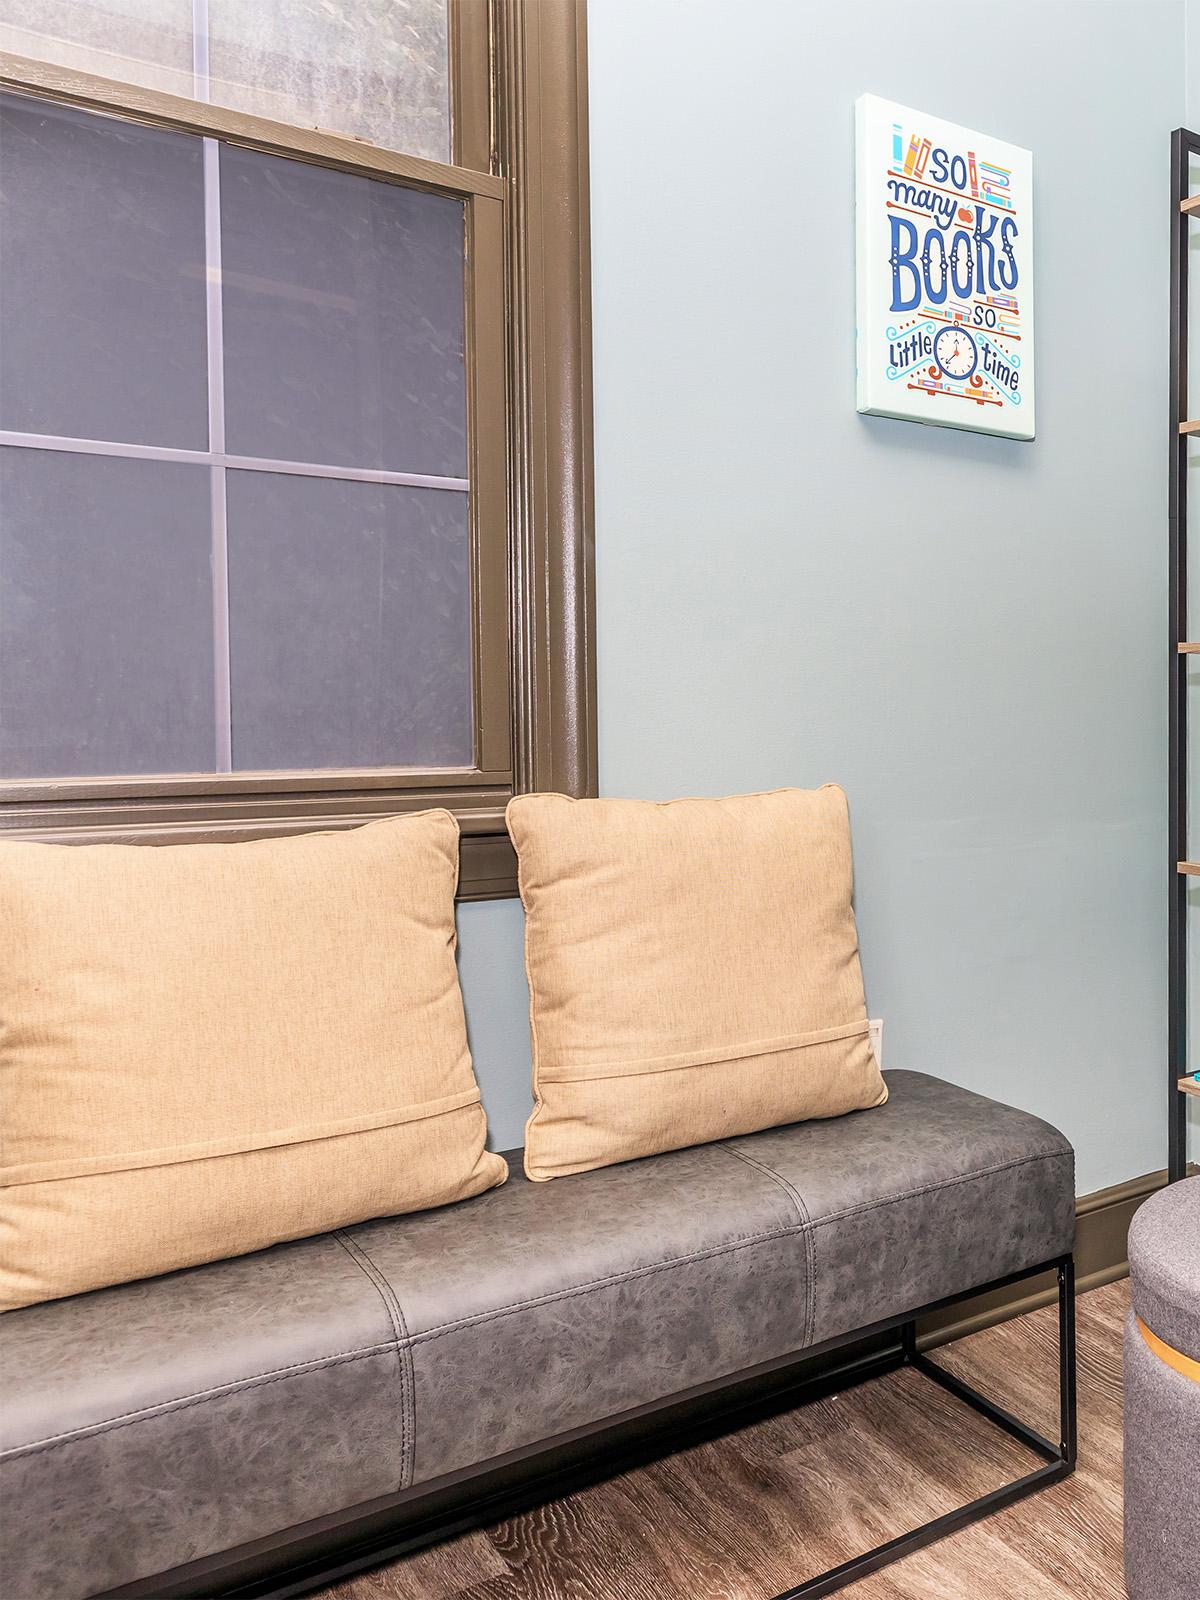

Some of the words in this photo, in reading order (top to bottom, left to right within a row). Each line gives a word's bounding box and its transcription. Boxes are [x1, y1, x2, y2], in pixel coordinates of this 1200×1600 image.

[930, 149, 967, 190] SO
[888, 180, 957, 230] many
[888, 205, 1018, 312] BOOKS
[973, 305, 996, 328] SO
[890, 332, 932, 368] Little
[982, 343, 1019, 391] time
